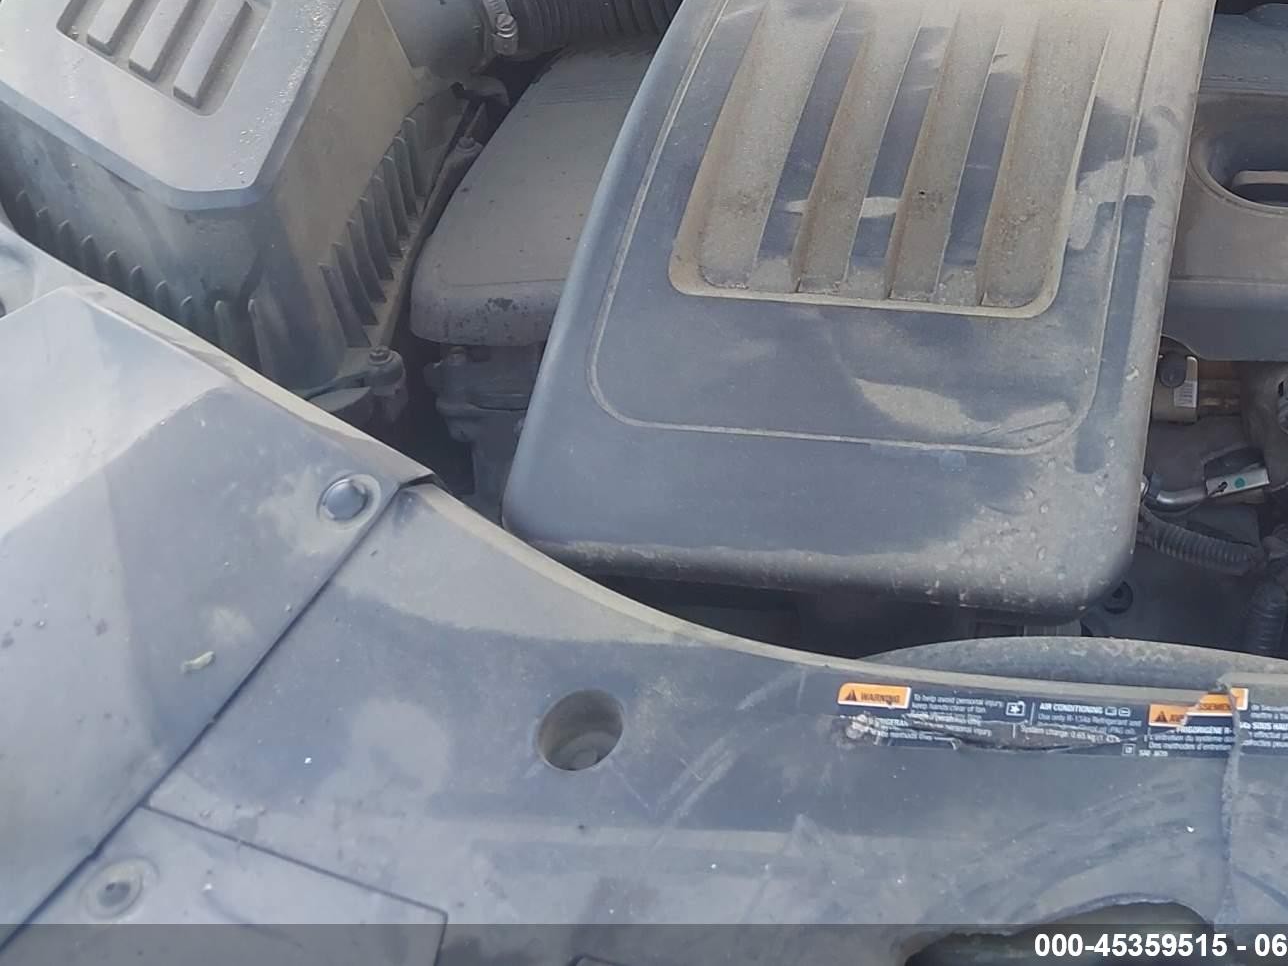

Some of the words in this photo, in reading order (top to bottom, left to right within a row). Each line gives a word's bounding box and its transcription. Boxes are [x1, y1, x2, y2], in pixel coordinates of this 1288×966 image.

[861, 692, 901, 704] WARNING
[1039, 702, 1052, 711] AIR
[1053, 703, 1103, 714] CONDITIONING
